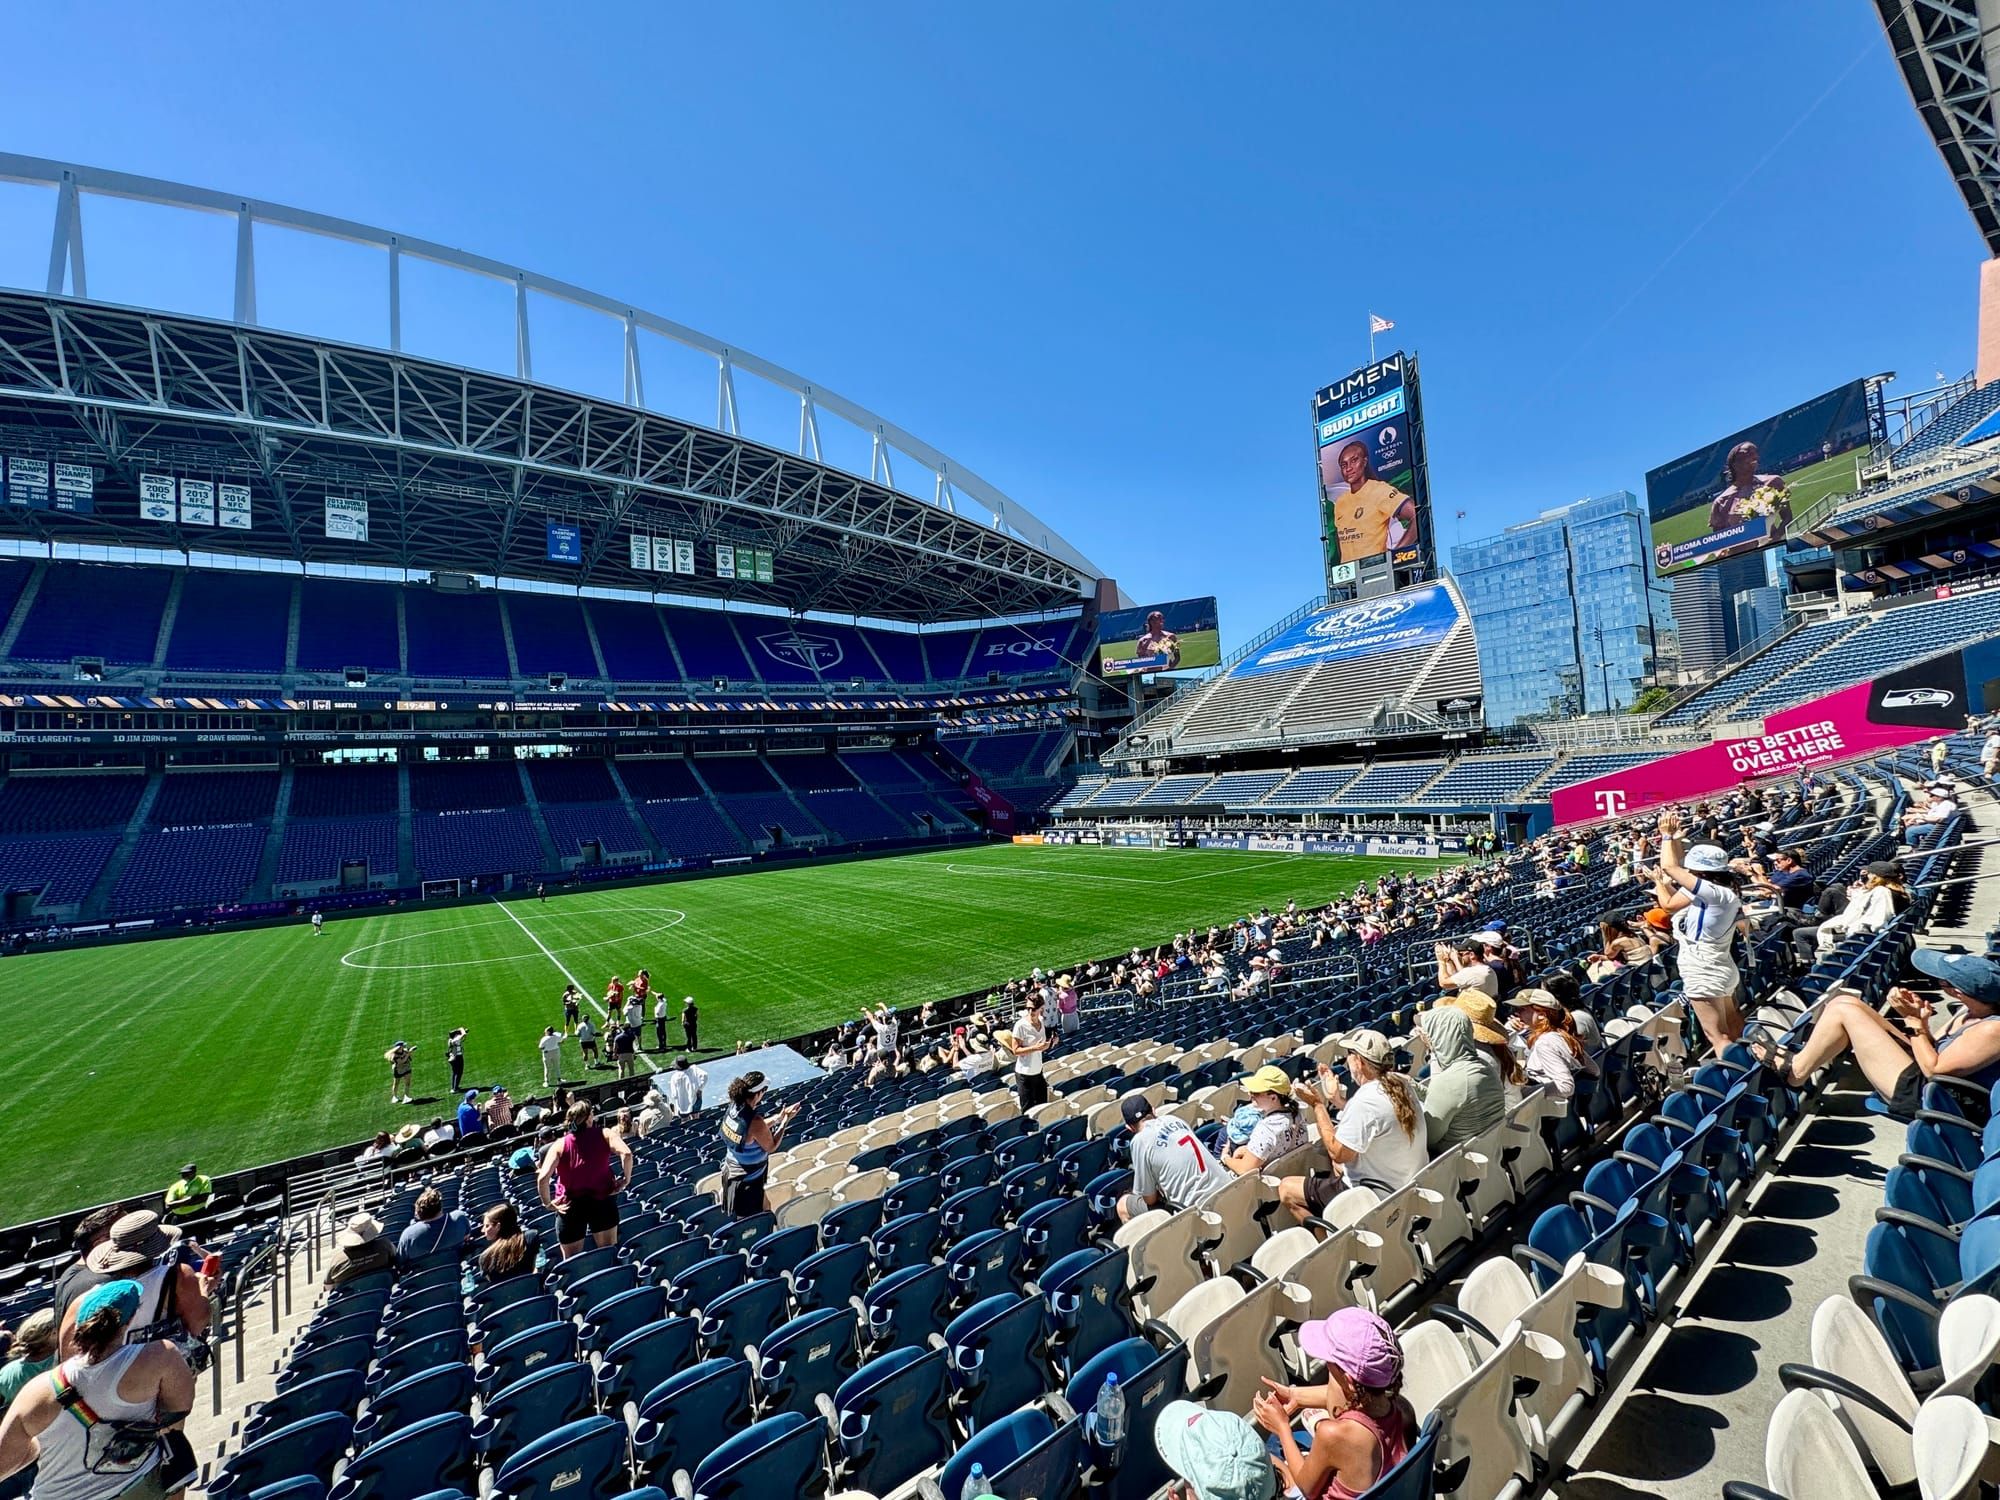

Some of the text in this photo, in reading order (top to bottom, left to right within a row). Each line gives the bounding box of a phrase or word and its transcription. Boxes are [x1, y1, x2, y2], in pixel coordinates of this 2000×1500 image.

[1317, 357, 1399, 407] LUMEN
[1340, 386, 1376, 408] FIELD
[1323, 395, 1399, 438] BUD LIGHT
[10, 464, 48, 474] CHAMPS
[56, 470, 91, 479] CHAMPS
[146, 484, 170, 494] 2005
[185, 490, 209, 499] 2013
[149, 492, 167, 500] NFC
[223, 494, 246, 503] 2014
[326, 503, 367, 512] CHAMPIONS
[1702, 525, 1745, 545] ONUMONU
[1673, 540, 1701, 554] IFEOMA
[1951, 583, 1980, 594] TOYOTA
[1315, 604, 1404, 632] EQC
[1339, 634, 1384, 650] CASINO
[1383, 626, 1425, 642] PITCH
[984, 638, 1056, 656] EQC
[12, 735, 37, 743] STEVE
[37, 735, 73, 743] LARGENT
[126, 734, 140, 742] JIM
[209, 734, 226, 742] DAVE
[227, 734, 251, 742] BROWN
[1726, 720, 1838, 758] IT'S BETTER
[1732, 734, 1846, 772] OVER HERE
[1595, 790, 1627, 819] T
[1206, 840, 1232, 849] MultiCare
[1256, 841, 1285, 851] MultiCare
[1312, 844, 1345, 853] MultiCare
[1377, 845, 1415, 856] MultiCare
[885, 1033, 897, 1044] 37
[1177, 1134, 1207, 1174] 7
